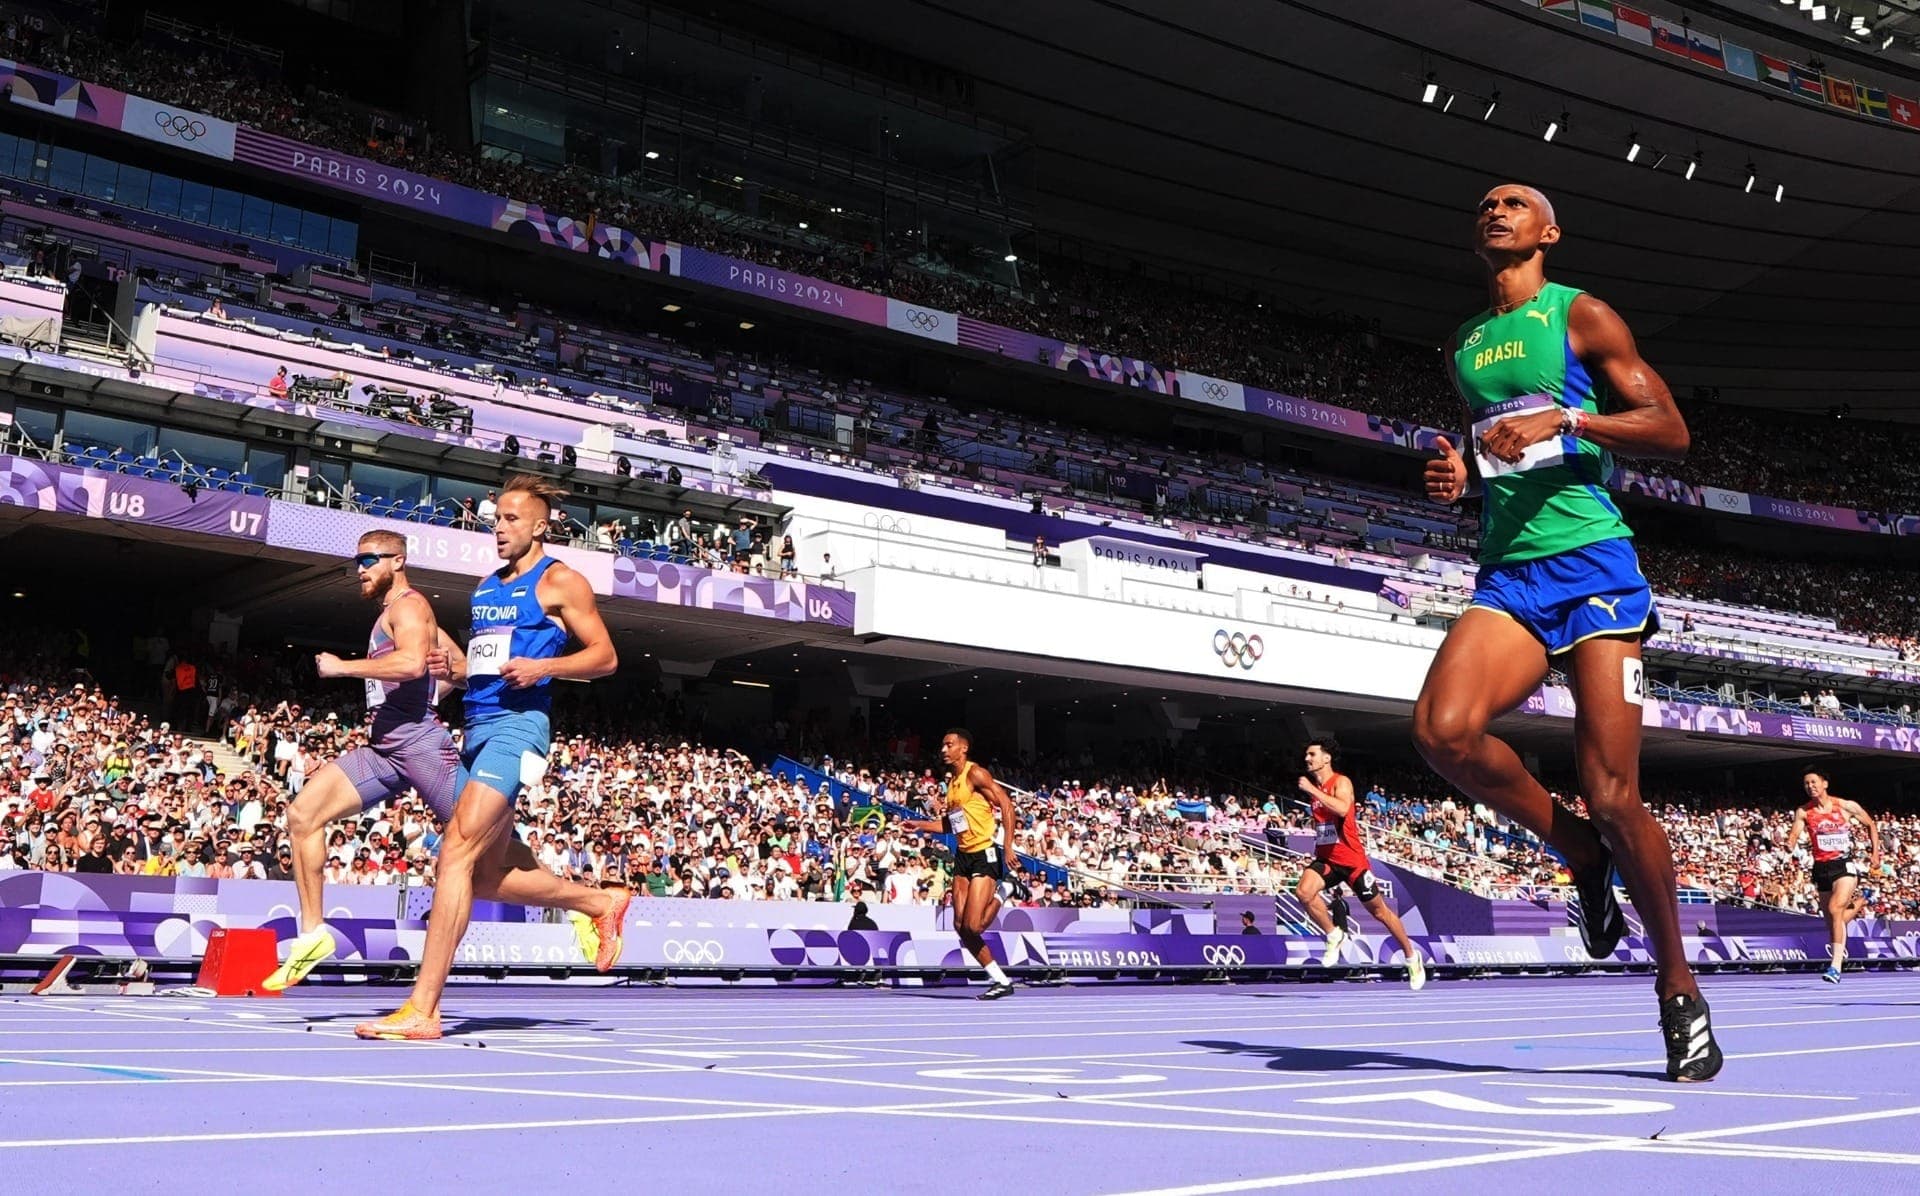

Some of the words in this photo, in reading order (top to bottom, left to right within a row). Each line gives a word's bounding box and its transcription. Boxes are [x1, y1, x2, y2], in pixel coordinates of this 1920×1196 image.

[293, 151, 367, 185] PARIS
[376, 173, 441, 205] 2024
[730, 265, 786, 293] PARIS
[794, 282, 843, 308] 2024
[1474, 340, 1526, 370] BRASIL
[1266, 397, 1307, 418] PARIS
[1311, 408, 1347, 427] 2024
[109, 491, 145, 518] U8
[1771, 503, 1802, 518] PARIS
[1805, 508, 1836, 523] 2024
[229, 510, 262, 536] U7
[406, 533, 449, 559] RIS
[460, 543, 494, 564] 20
[1095, 546, 1141, 567] PARIS
[1147, 556, 1189, 574] 2024
[809, 599, 832, 620] U6
[1633, 668, 1642, 695] 2
[1527, 696, 1545, 711] S13
[1747, 720, 1763, 734] S12
[1781, 724, 1793, 737] S8
[1805, 723, 1834, 738] PARIS
[1836, 726, 1862, 740] 2024
[464, 944, 523, 962] ARIS
[531, 944, 579, 962] 202
[1060, 950, 1112, 966] PARIS
[1116, 950, 1161, 966] 2024
[1467, 951, 1504, 963] PARIS
[1755, 949, 1783, 961] PARIS
